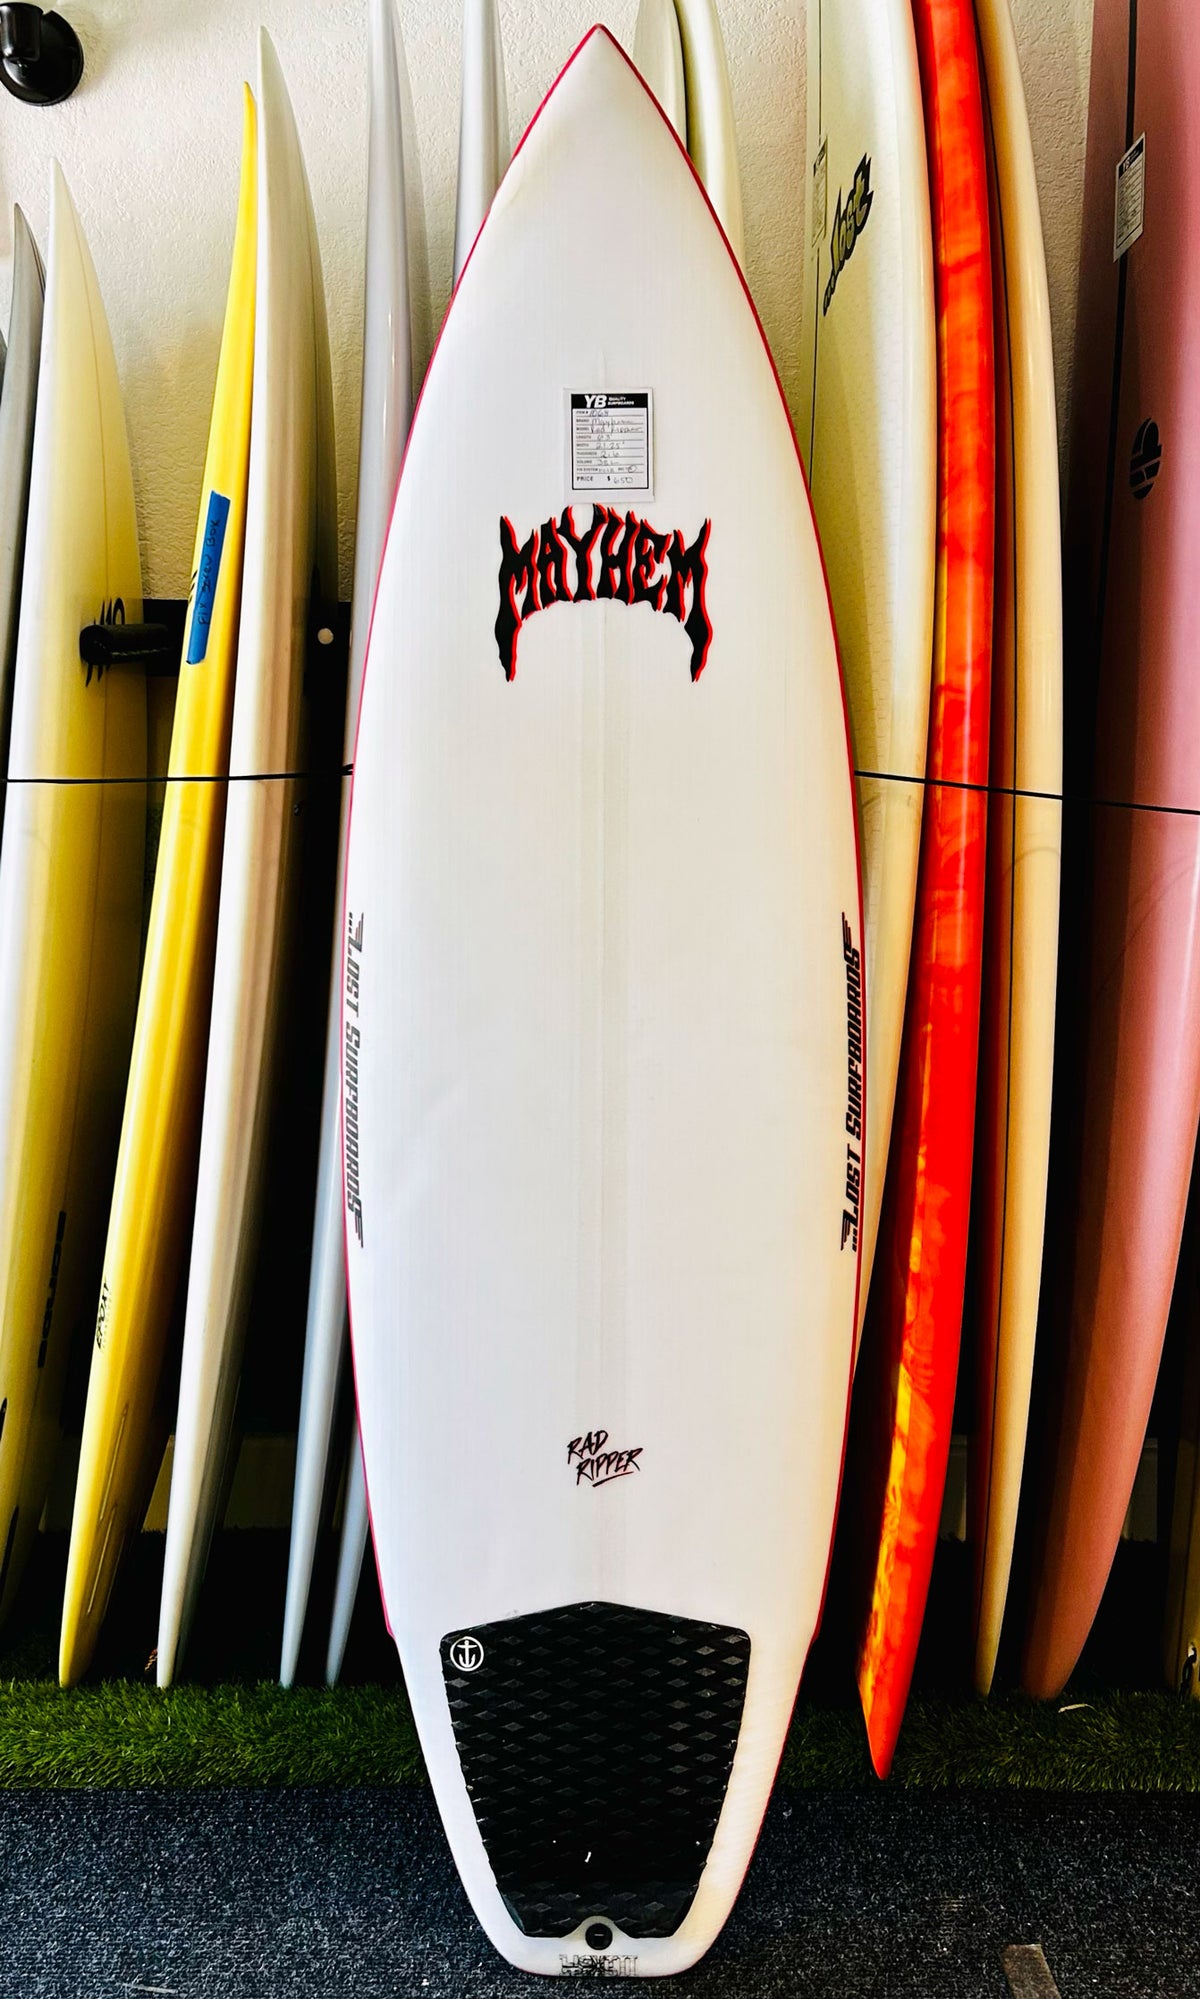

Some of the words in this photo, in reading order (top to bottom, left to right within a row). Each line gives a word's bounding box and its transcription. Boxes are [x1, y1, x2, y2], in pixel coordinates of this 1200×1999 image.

[584, 395, 607, 408] YB
[495, 503, 713, 682] MAYHEM
[567, 1430, 608, 1464] RAD
[576, 1447, 643, 1486] RIPPER
